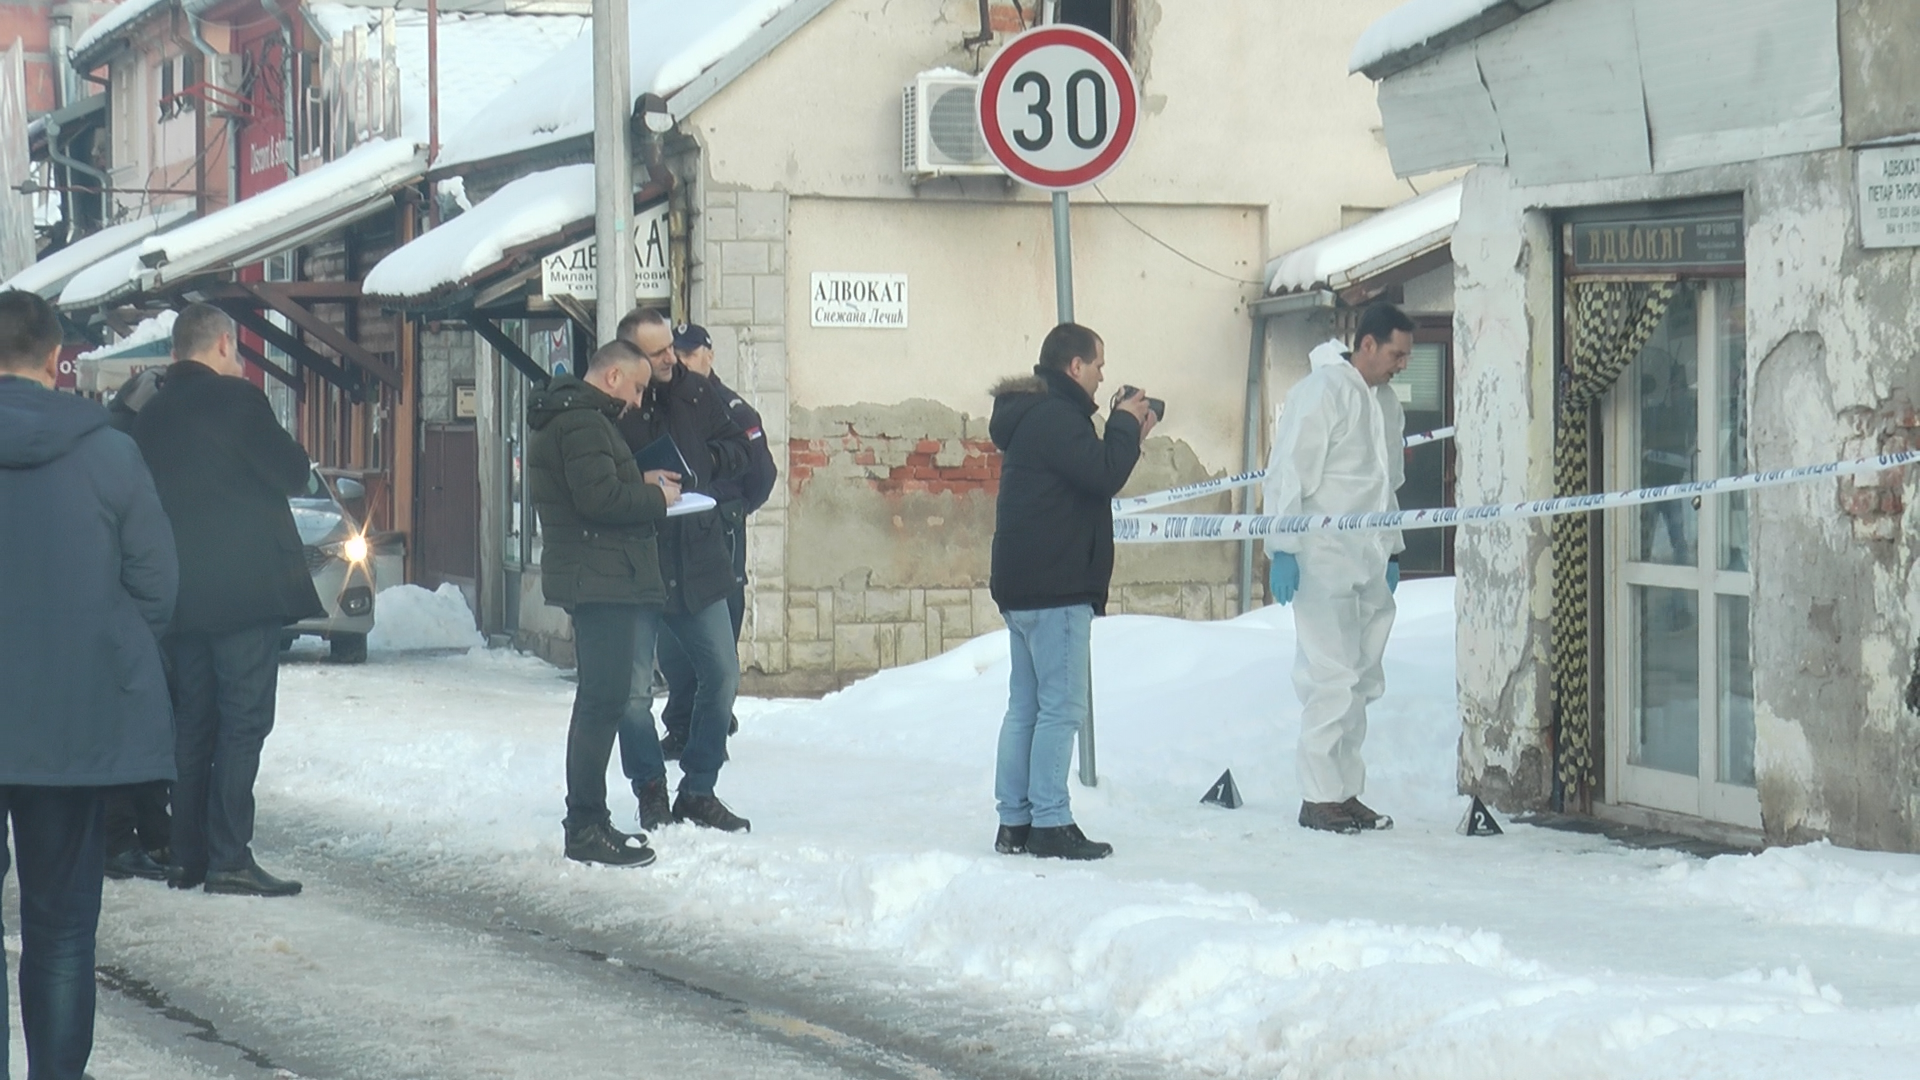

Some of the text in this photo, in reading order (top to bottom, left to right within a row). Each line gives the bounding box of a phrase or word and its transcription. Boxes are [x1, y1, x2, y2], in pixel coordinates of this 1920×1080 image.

[1013, 68, 1107, 152] 30
[1588, 227, 1685, 263] АДВОКАТ
[550, 271, 593, 282] Милан
[814, 280, 905, 305] АДВОКАТ
[814, 306, 904, 324] Снежана Лечић
[1217, 783, 1225, 800] 1
[1475, 811, 1487, 830] 2
